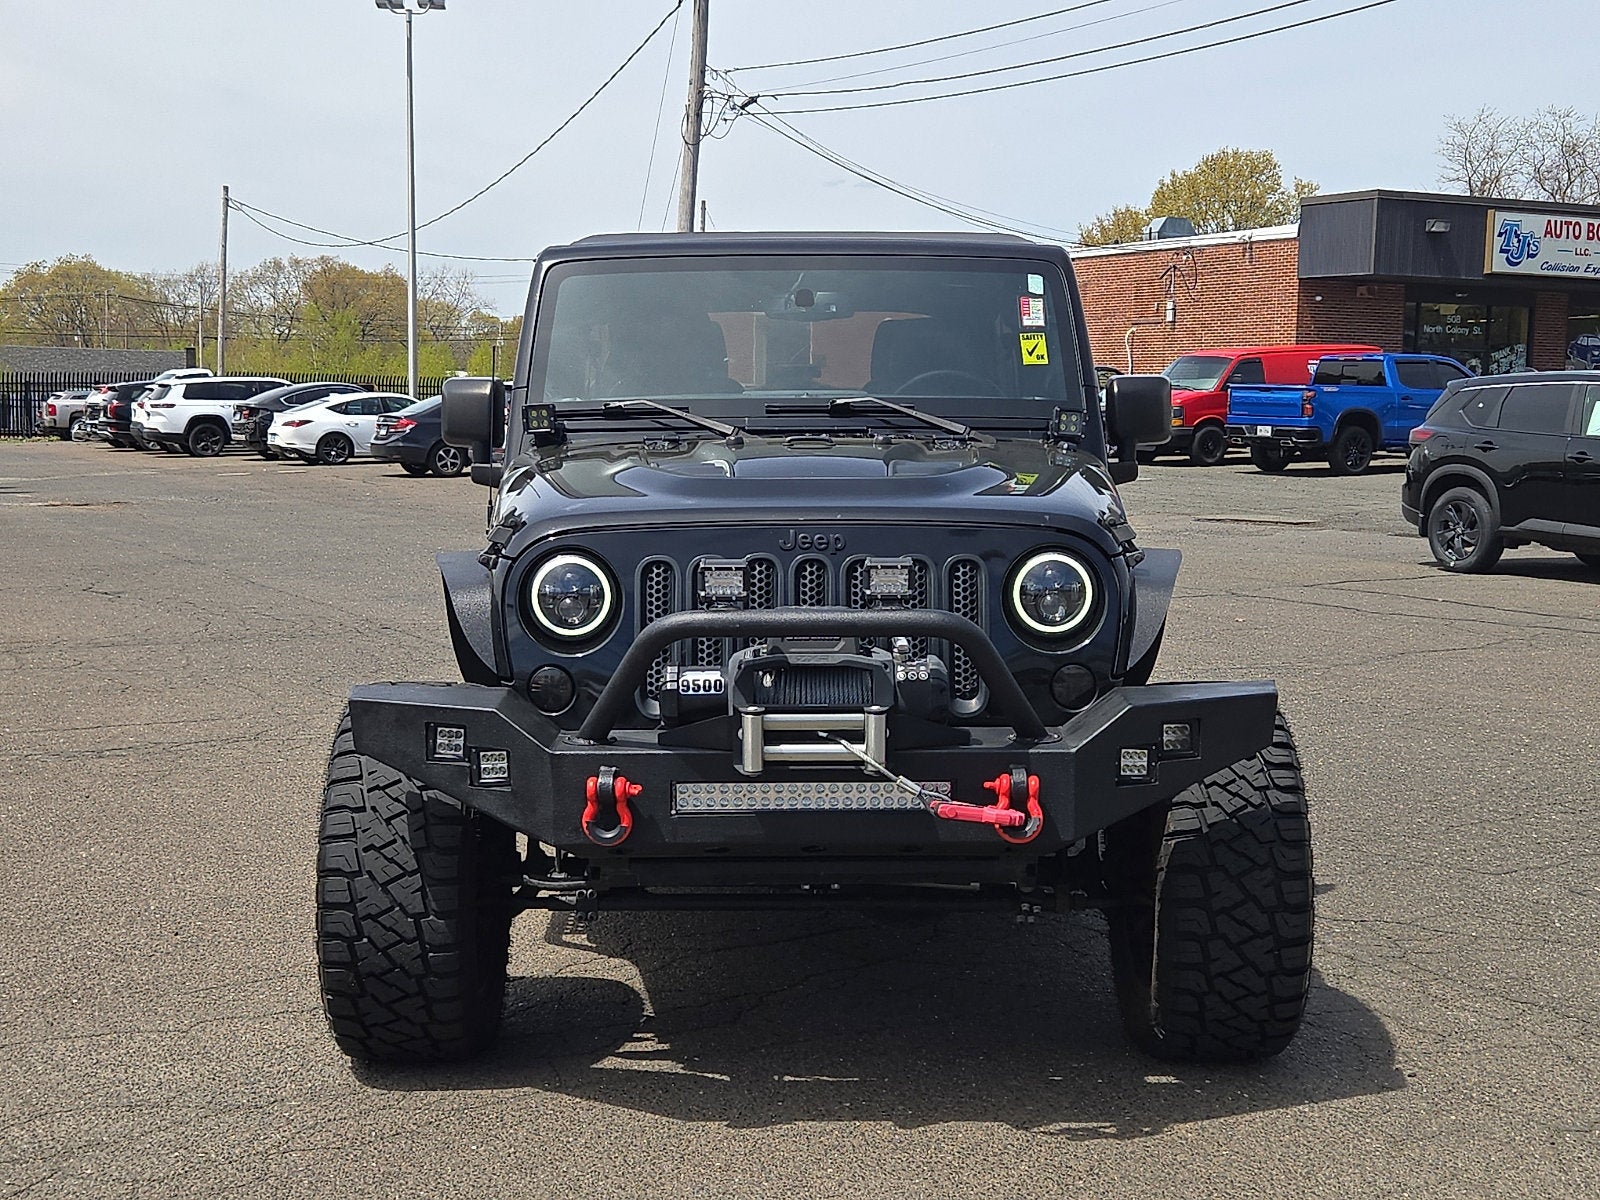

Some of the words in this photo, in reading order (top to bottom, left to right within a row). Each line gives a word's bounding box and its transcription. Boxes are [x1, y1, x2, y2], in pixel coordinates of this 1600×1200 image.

[1544, 219, 1582, 241] AUTO
[1497, 218, 1541, 267] TJ's
[1574, 247, 1592, 257] LLC.
[1540, 261, 1580, 273] Collision
[1423, 324, 1443, 333] North
[1445, 325, 1470, 336] Colony
[779, 529, 846, 555] Jeep
[680, 679, 723, 693] 9500
